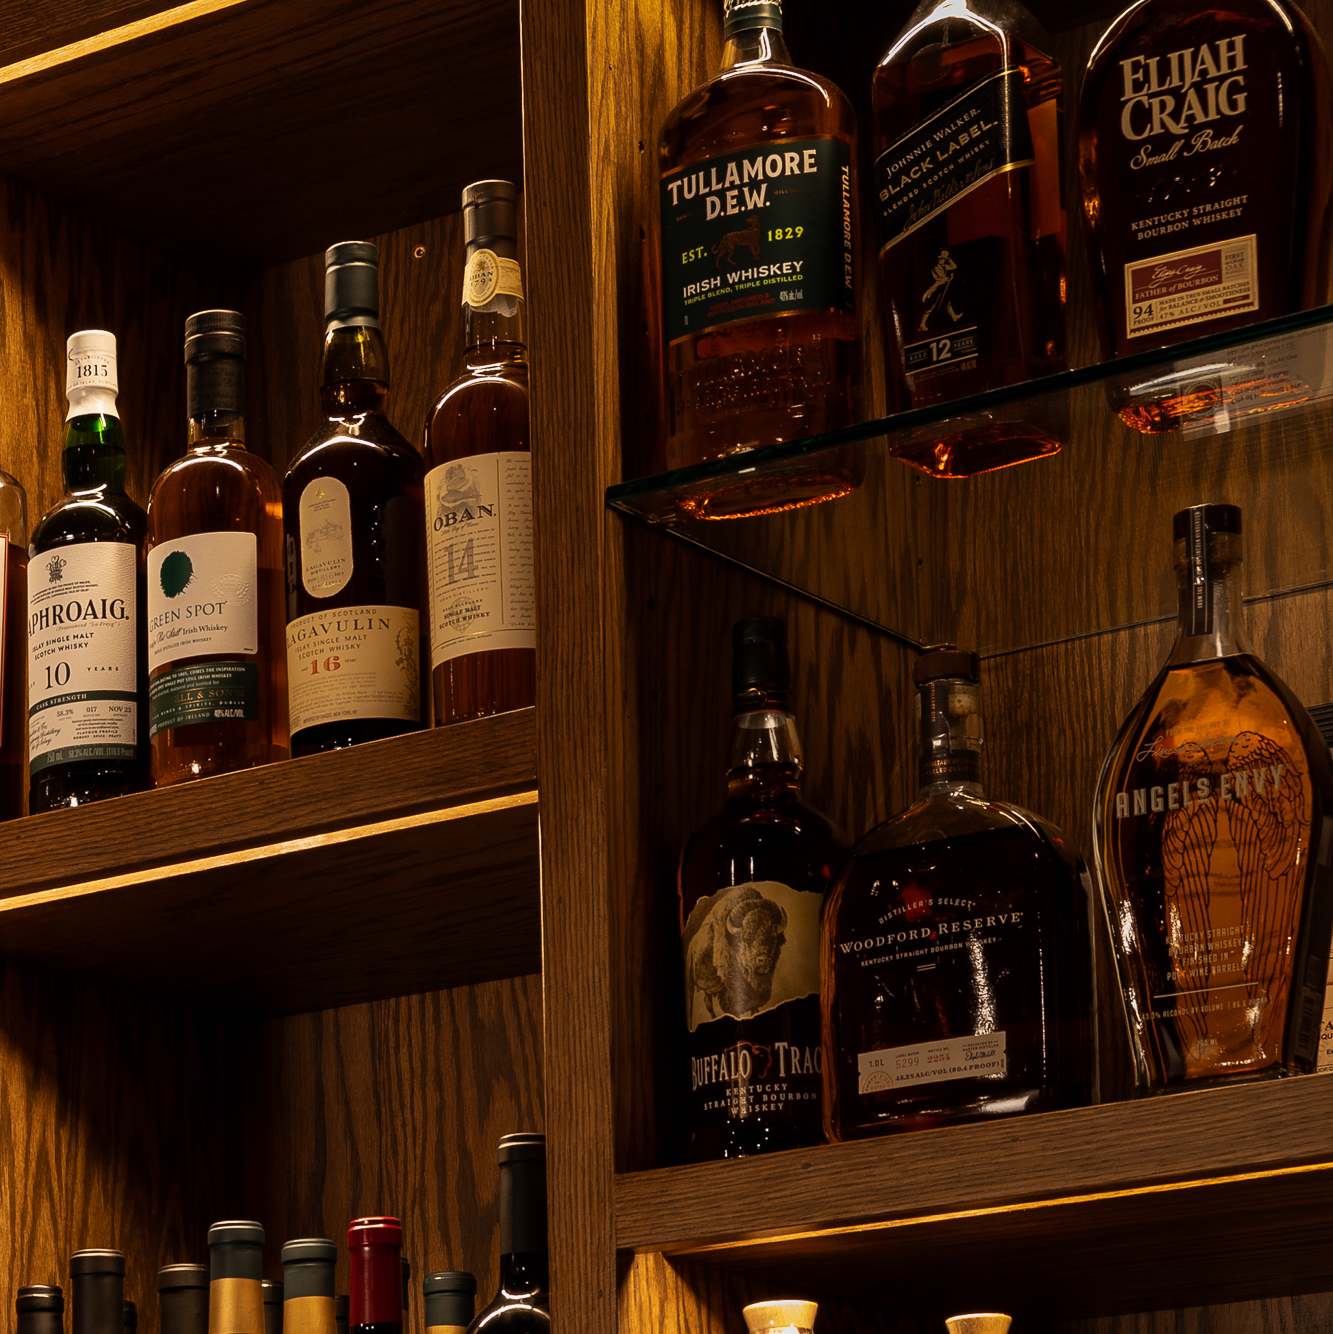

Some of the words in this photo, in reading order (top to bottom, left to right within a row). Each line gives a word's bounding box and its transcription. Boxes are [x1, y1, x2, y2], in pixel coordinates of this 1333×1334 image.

[1119, 33, 1249, 102] ELIJAH
[1120, 75, 1249, 141] CRAIG
[886, 139, 933, 179] JOHNNIE
[1130, 139, 1185, 170] Small
[1183, 124, 1244, 157] Batch
[667, 149, 818, 206] TULLAMORE
[879, 157, 933, 202] BLACK
[705, 183, 771, 221] D.E.W.
[1131, 208, 1190, 231] KENTUCKY
[767, 226, 804, 242] 1829
[681, 246, 708, 264] EST.
[683, 276, 721, 298] IRISH
[726, 260, 804, 284] WHISKEY
[763, 273, 804, 286] DISTILLED
[77, 364, 108, 379] 1815
[444, 537, 479, 585] 14
[149, 608, 181, 633] GREEN
[185, 601, 225, 619] SPOT
[439, 617, 462, 630] SCOTCH
[462, 611, 491, 623] WHISKY
[443, 606, 464, 621] SINGLE
[464, 604, 482, 615] MALT
[287, 618, 391, 649] LAGAVULIN
[344, 634, 368, 642] MALT
[44, 661, 71, 690] 10
[310, 655, 341, 675] 16
[1220, 763, 1285, 800] ENVY
[878, 899, 934, 925] DISTILLER'S
[840, 927, 931, 955] WOODFORD
[938, 914, 1022, 935] RESERVE
[1207, 925, 1244, 938] STRAIGHT
[860, 955, 894, 968] KENTUCKY
[895, 948, 928, 961] STRAIGHT
[930, 942, 964, 954] BOURBON
[691, 1048, 752, 1091] BUFFALO
[774, 1041, 821, 1077] TRAC
[703, 1095, 755, 1111] STRAIGHT
[762, 1092, 817, 1102] BOURBON
[725, 1083, 788, 1097] KENTUCKY
[731, 1102, 784, 1115] WHISKEY
